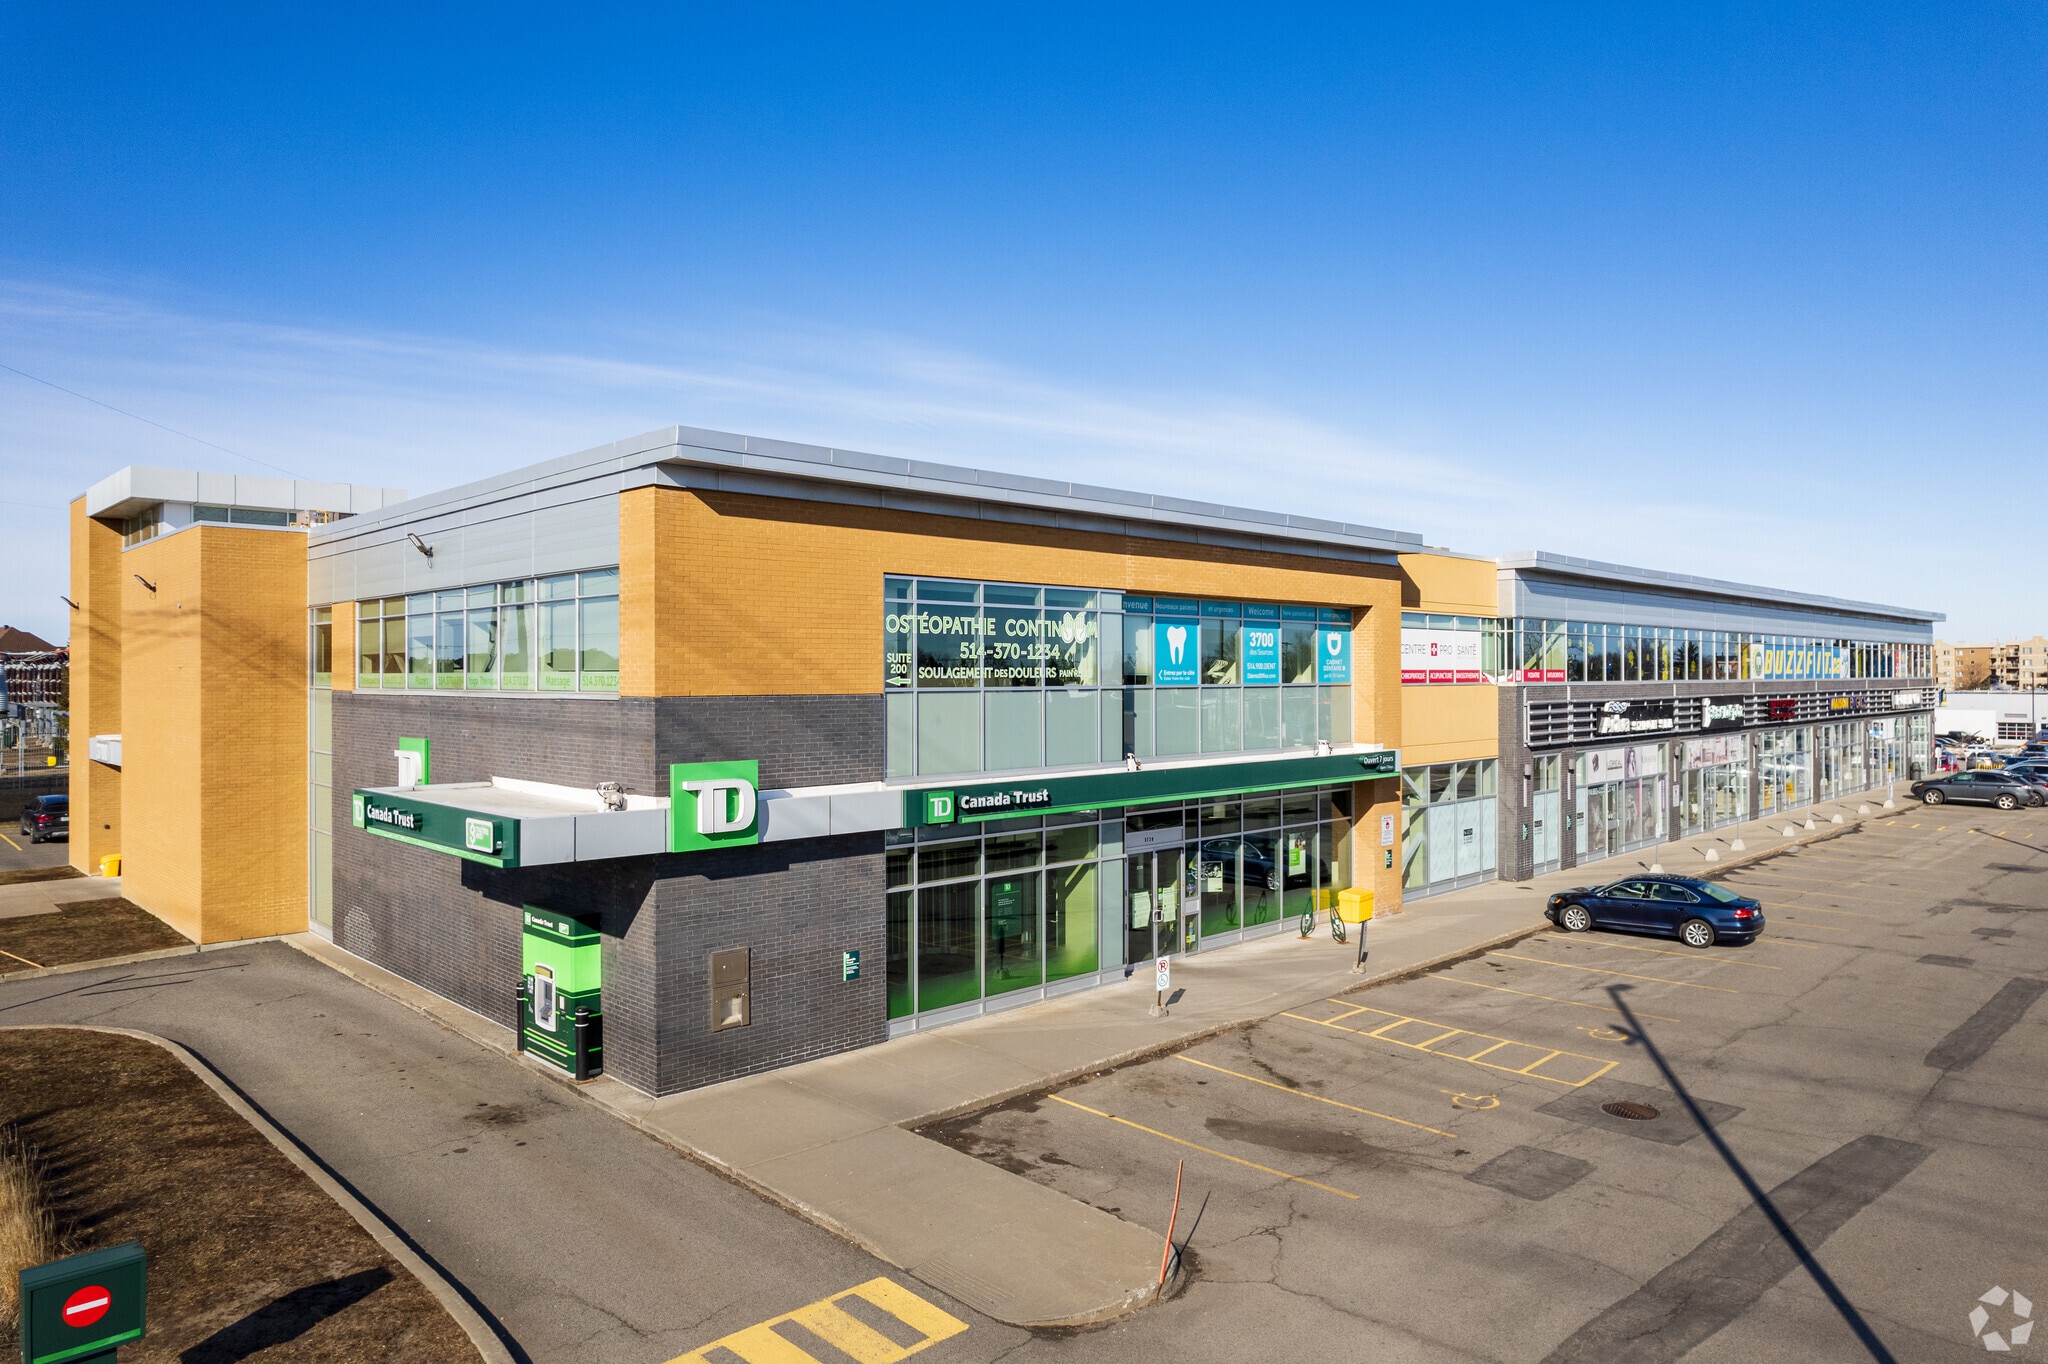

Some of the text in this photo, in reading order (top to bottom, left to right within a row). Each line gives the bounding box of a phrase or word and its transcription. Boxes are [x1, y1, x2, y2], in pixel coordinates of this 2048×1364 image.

[1123, 600, 1149, 610] nvenue
[1155, 601, 1198, 612] Nouveaux patients
[1248, 606, 1274, 616] Welcome
[885, 611, 996, 636] OSTÉOPATHIE
[1249, 632, 1274, 647] 3700
[960, 641, 1060, 660] 514-370-1234
[1249, 648, 1257, 656] des
[1401, 643, 1477, 656] CENTRE PRO SANTÉ
[886, 653, 912, 664] SUITE
[890, 664, 907, 674] 200
[918, 666, 993, 679] SOULAGEMENT
[994, 667, 1008, 679] DES
[1008, 666, 1056, 679] DOULEURS
[1059, 669, 1073, 678] PAIN
[545, 676, 570, 688] Massage
[1363, 756, 1379, 764] Ouvert
[1383, 755, 1394, 764] jours
[682, 777, 756, 835] TD
[930, 788, 1049, 817] TD Canada Trust
[354, 799, 414, 829] TD Canada Trust
